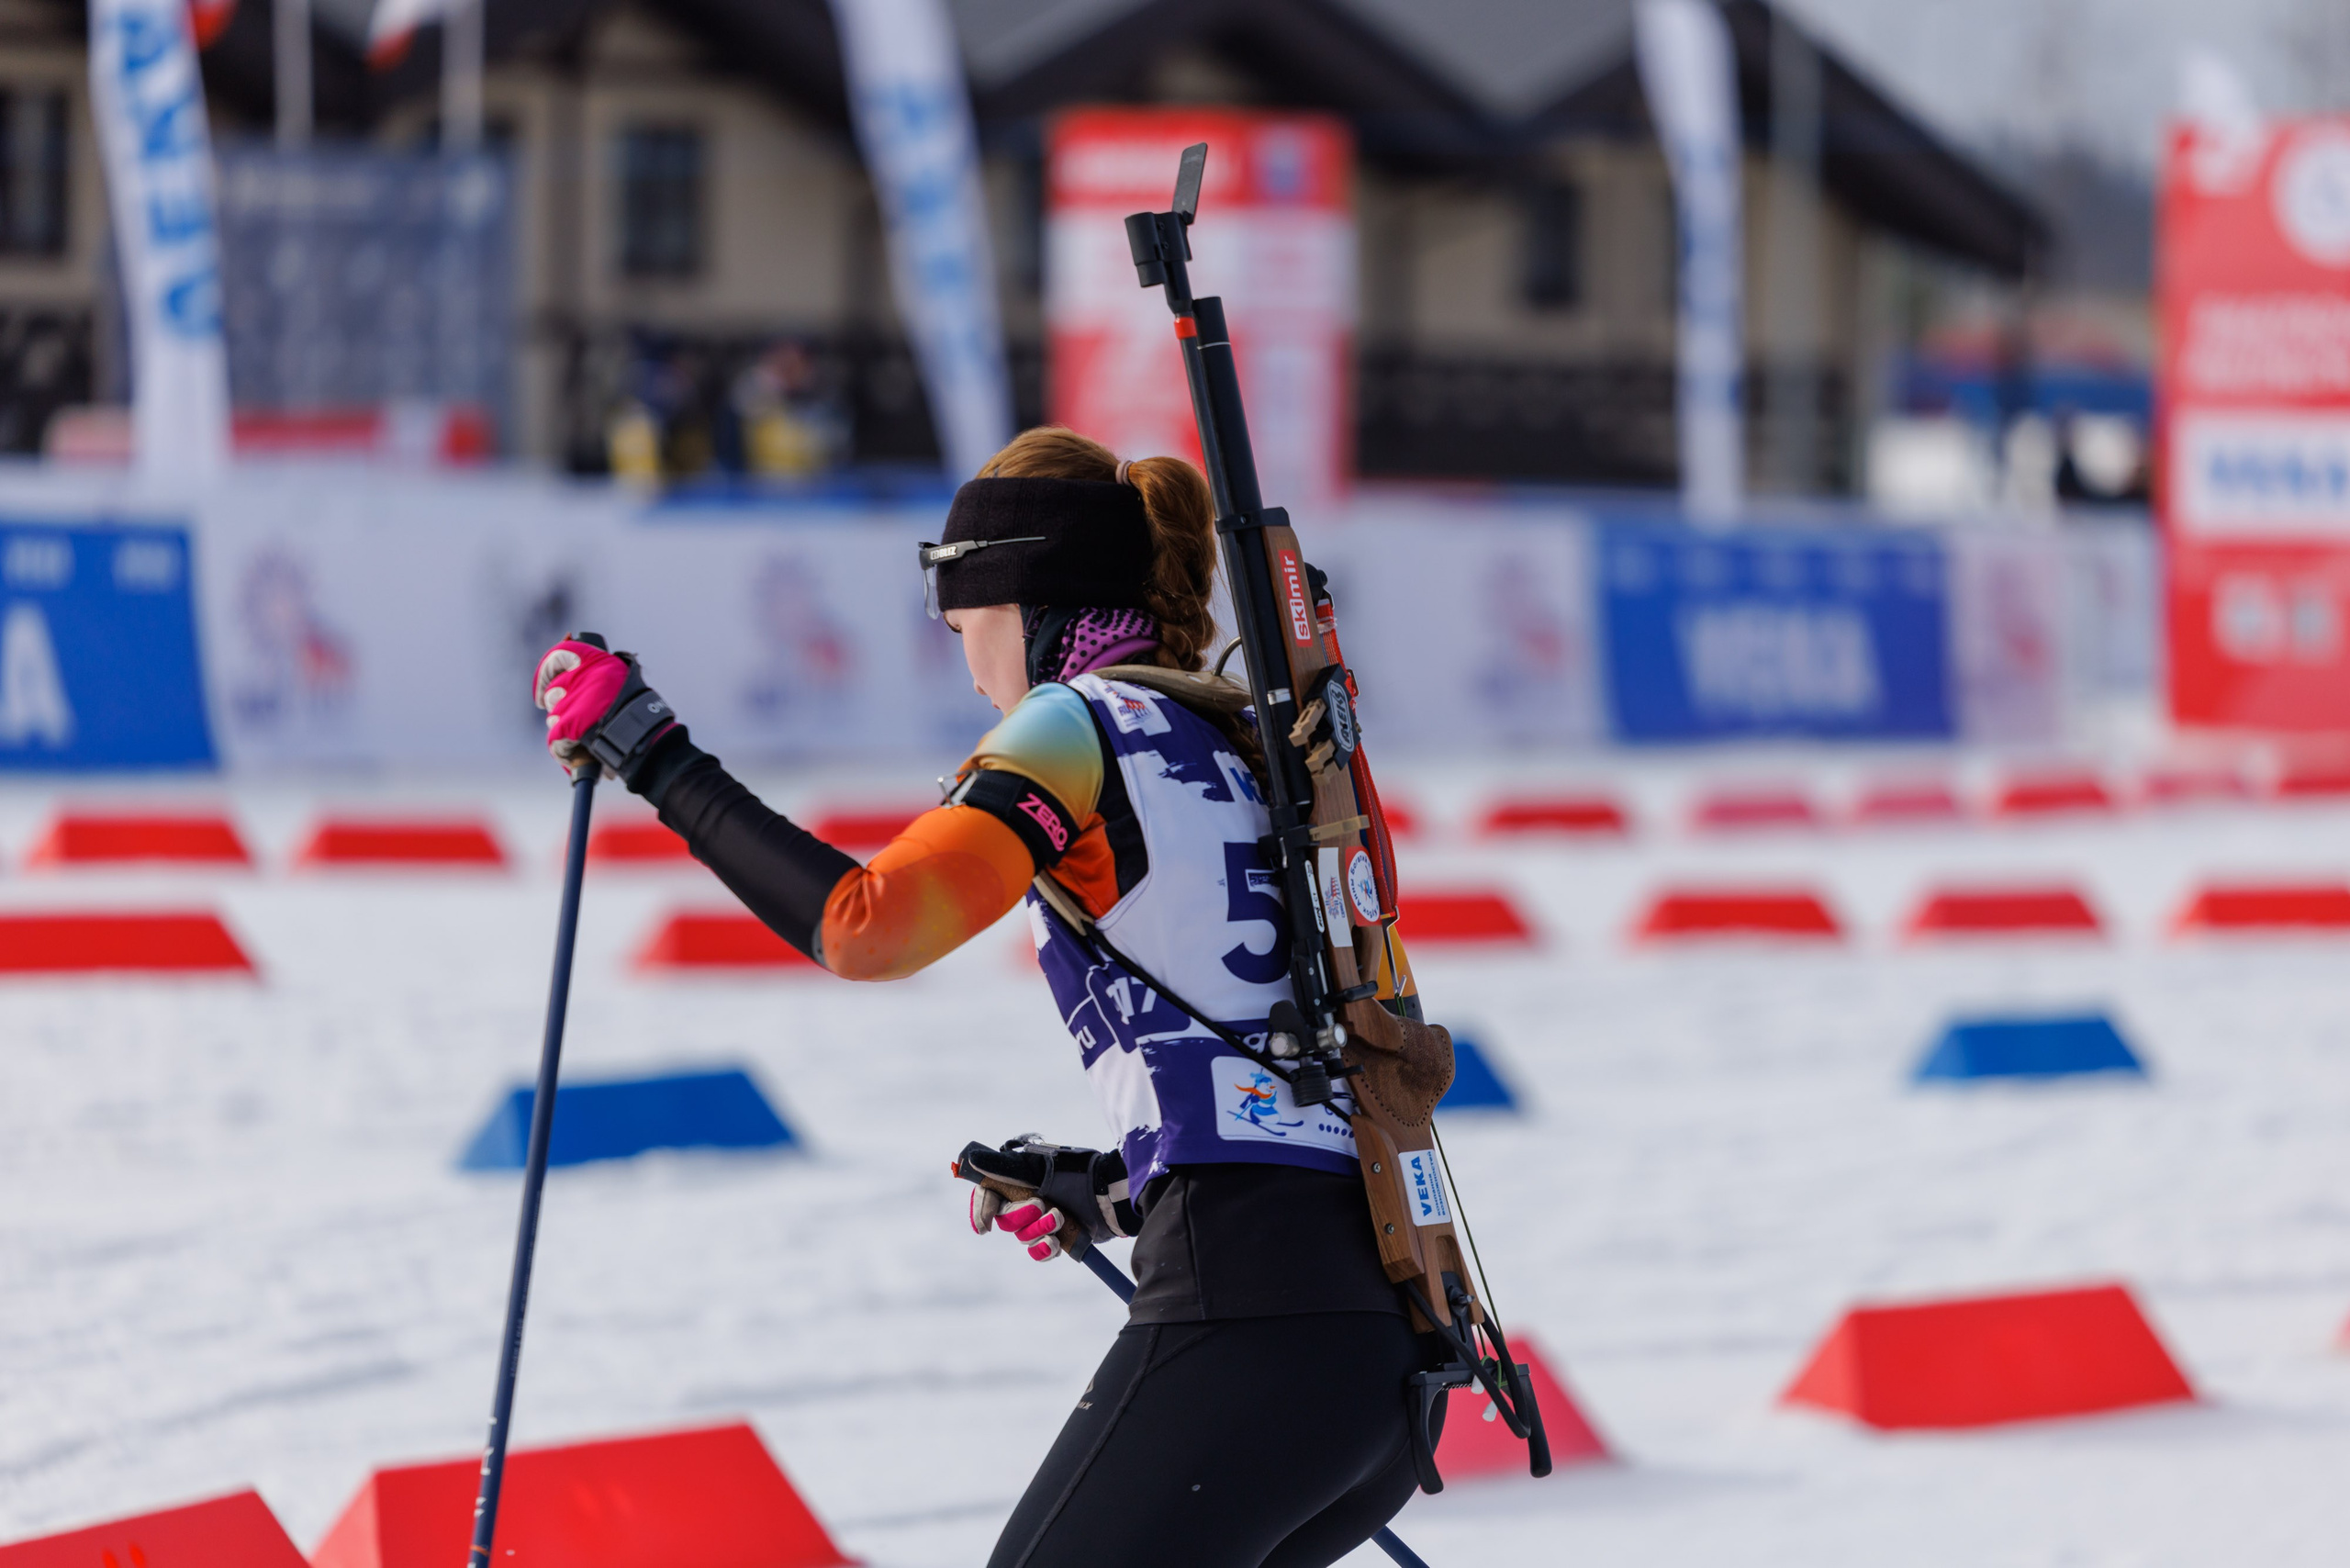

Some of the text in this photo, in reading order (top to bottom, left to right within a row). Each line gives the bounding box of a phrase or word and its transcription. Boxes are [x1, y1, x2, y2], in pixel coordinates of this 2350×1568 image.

[1283, 555, 1311, 638] skimir
[1016, 792, 1069, 852] ZERO
[1410, 1156, 1433, 1217] VEKA
